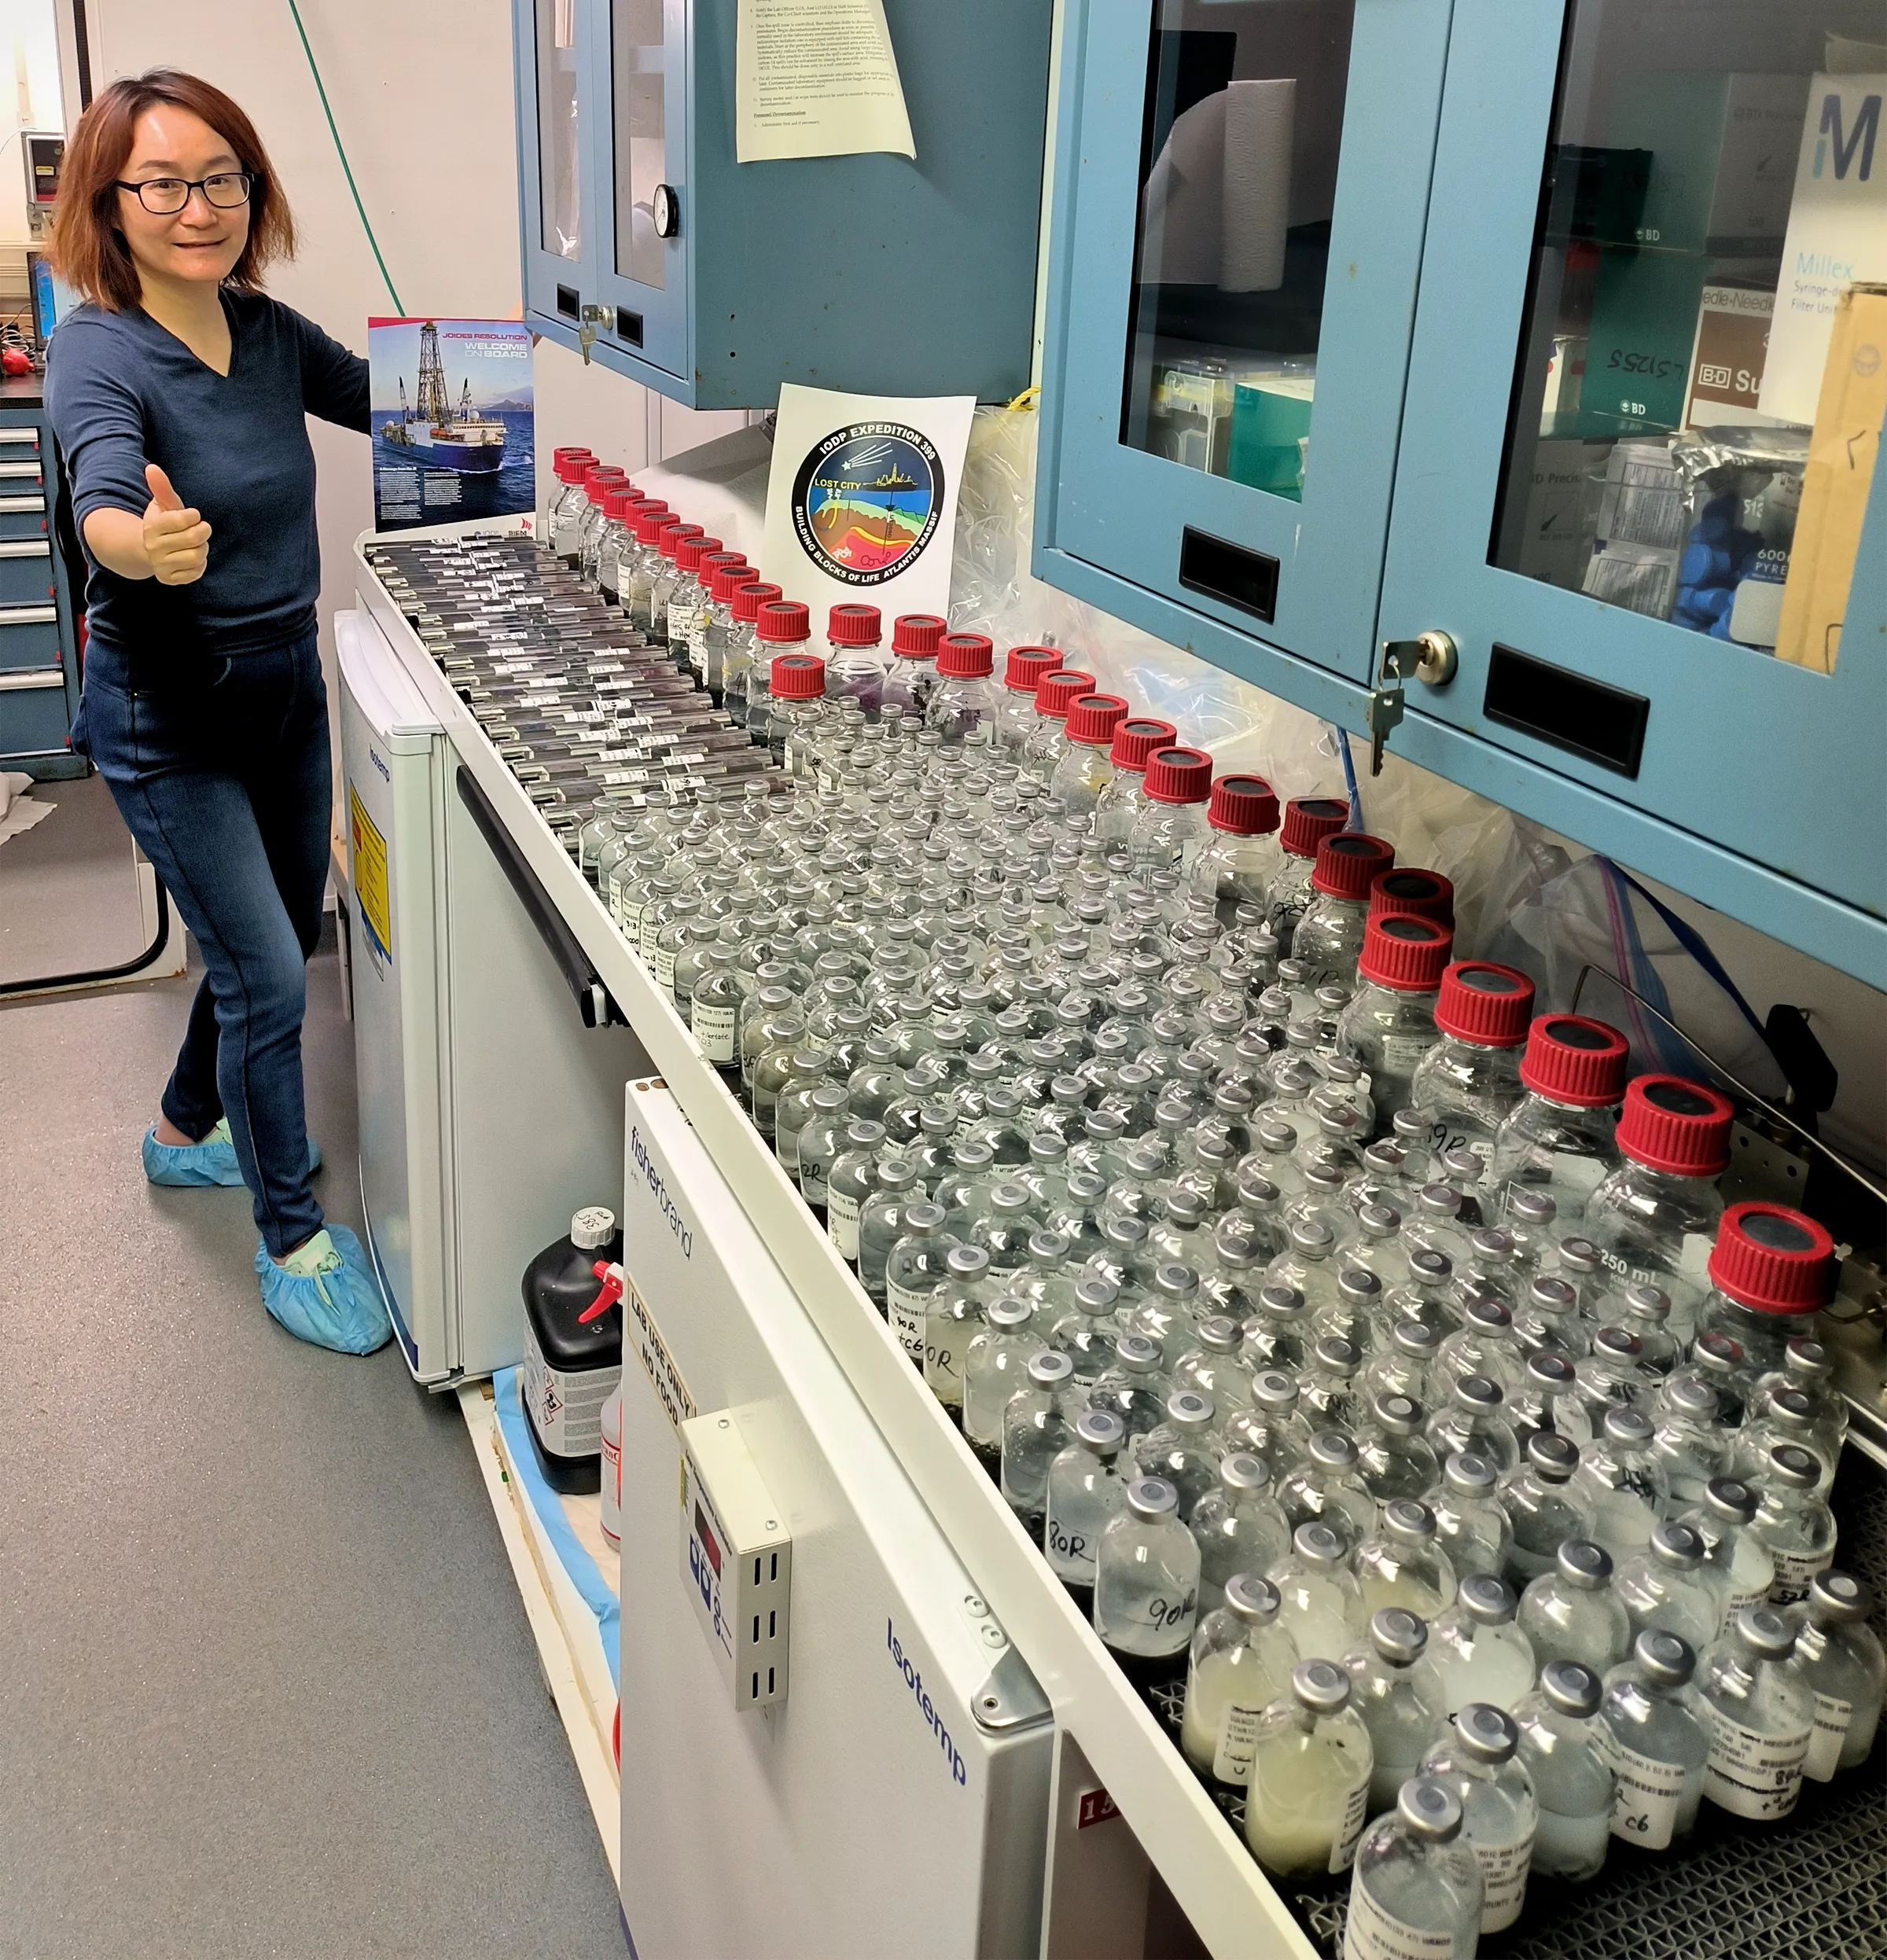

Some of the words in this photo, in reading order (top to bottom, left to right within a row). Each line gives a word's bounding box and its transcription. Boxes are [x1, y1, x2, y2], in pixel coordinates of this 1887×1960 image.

[1812, 94, 1882, 182] M
[1646, 229, 1660, 241] BD
[1797, 252, 1852, 279] Millex
[1791, 299, 1814, 311] Filter
[465, 342, 527, 351] WELCOME
[484, 350, 528, 359] BOARD
[1631, 403, 1646, 414] BD
[819, 432, 847, 454] IODP
[849, 424, 921, 445] EXPEDITION
[920, 441, 936, 461] 399
[815, 478, 838, 488] LOST
[841, 481, 862, 491] CITY
[795, 506, 815, 552] BUILDING
[813, 551, 848, 578] BLOCKS
[861, 573, 880, 583] LIFE
[883, 546, 920, 579] ATLANTIS
[918, 510, 939, 547] MASSIF
[631, 1125, 693, 1260] fisherbrand
[1601, 1248, 1628, 1274] 250
[1631, 1268, 1661, 1287] mL
[631, 1292, 647, 1332] LAB
[649, 1326, 665, 1370] USE
[667, 1363, 690, 1418] ONLY
[642, 1343, 654, 1375] NO
[656, 1370, 678, 1426] FOOD
[886, 1617, 967, 1786] Isotemp
